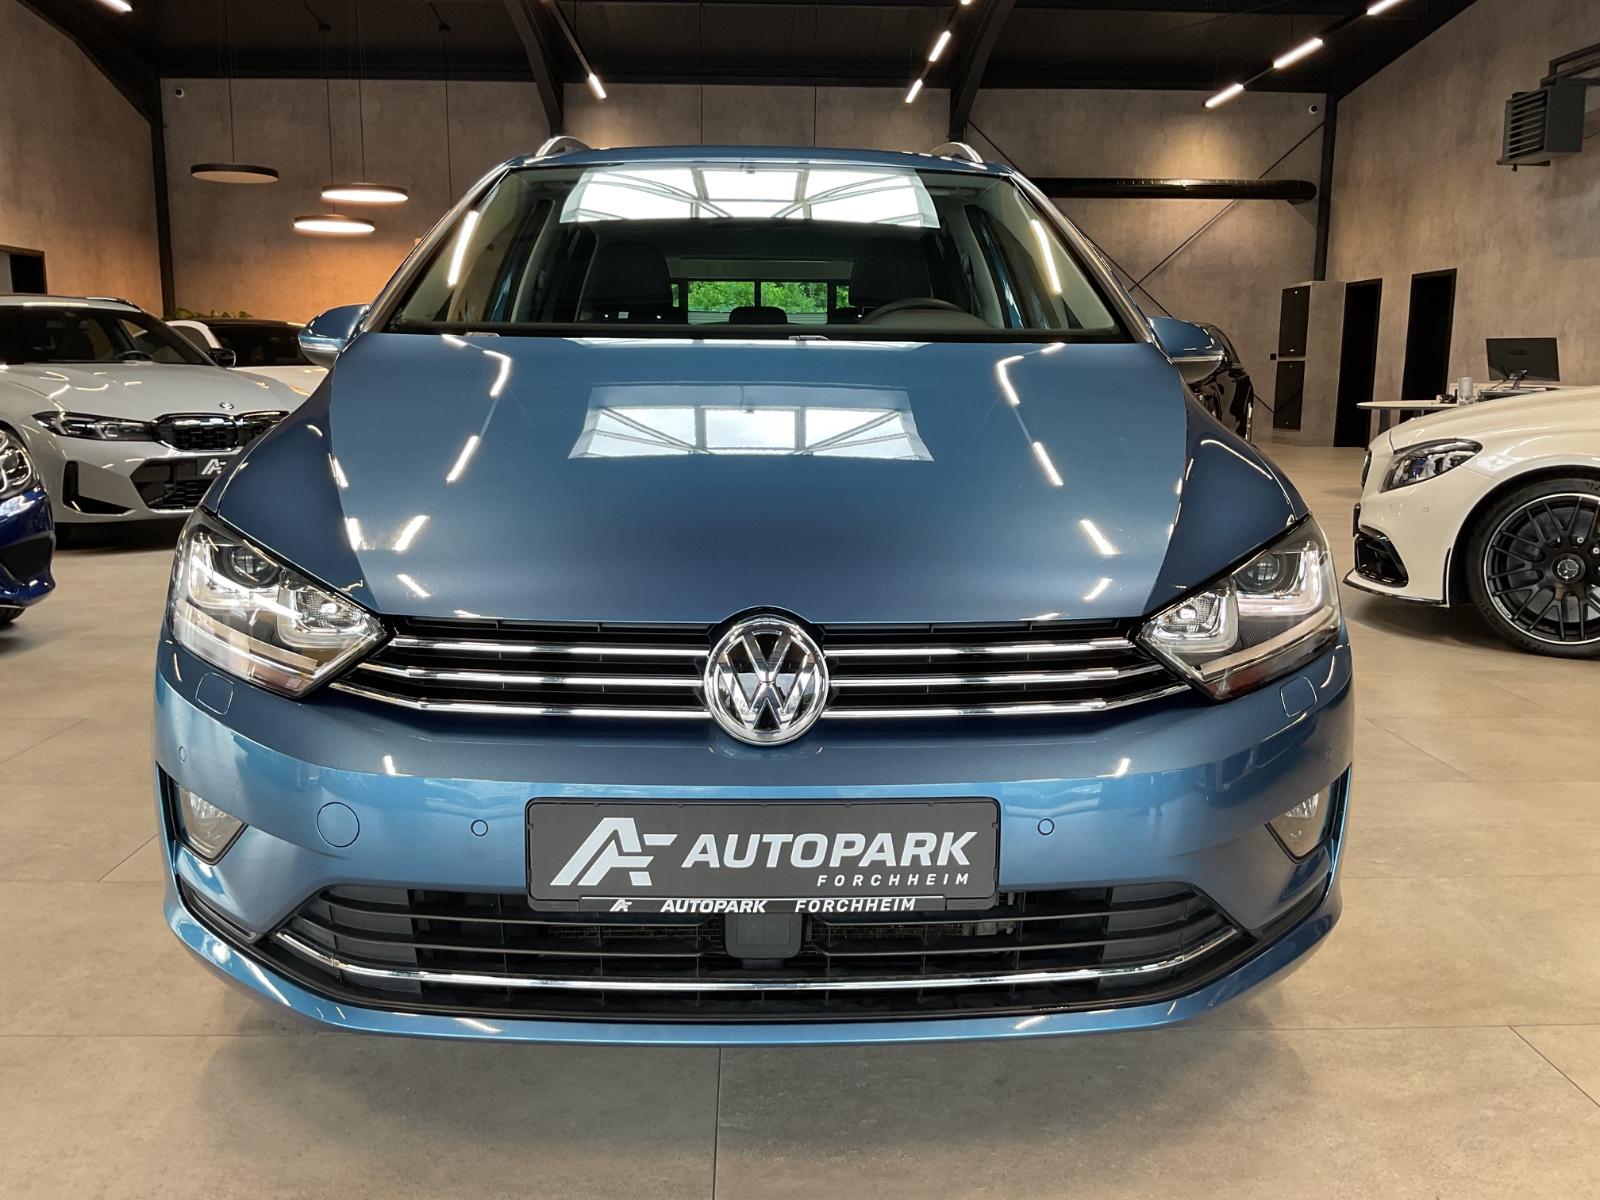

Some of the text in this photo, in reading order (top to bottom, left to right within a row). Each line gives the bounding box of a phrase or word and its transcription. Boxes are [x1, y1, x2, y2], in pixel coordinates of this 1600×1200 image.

[709, 619, 825, 738] VW
[681, 831, 978, 868] AUTOPARK
[816, 873, 970, 887] FORCHHEIM
[660, 899, 768, 913] AUTOPARK
[794, 898, 916, 913] FORCHHEIM
